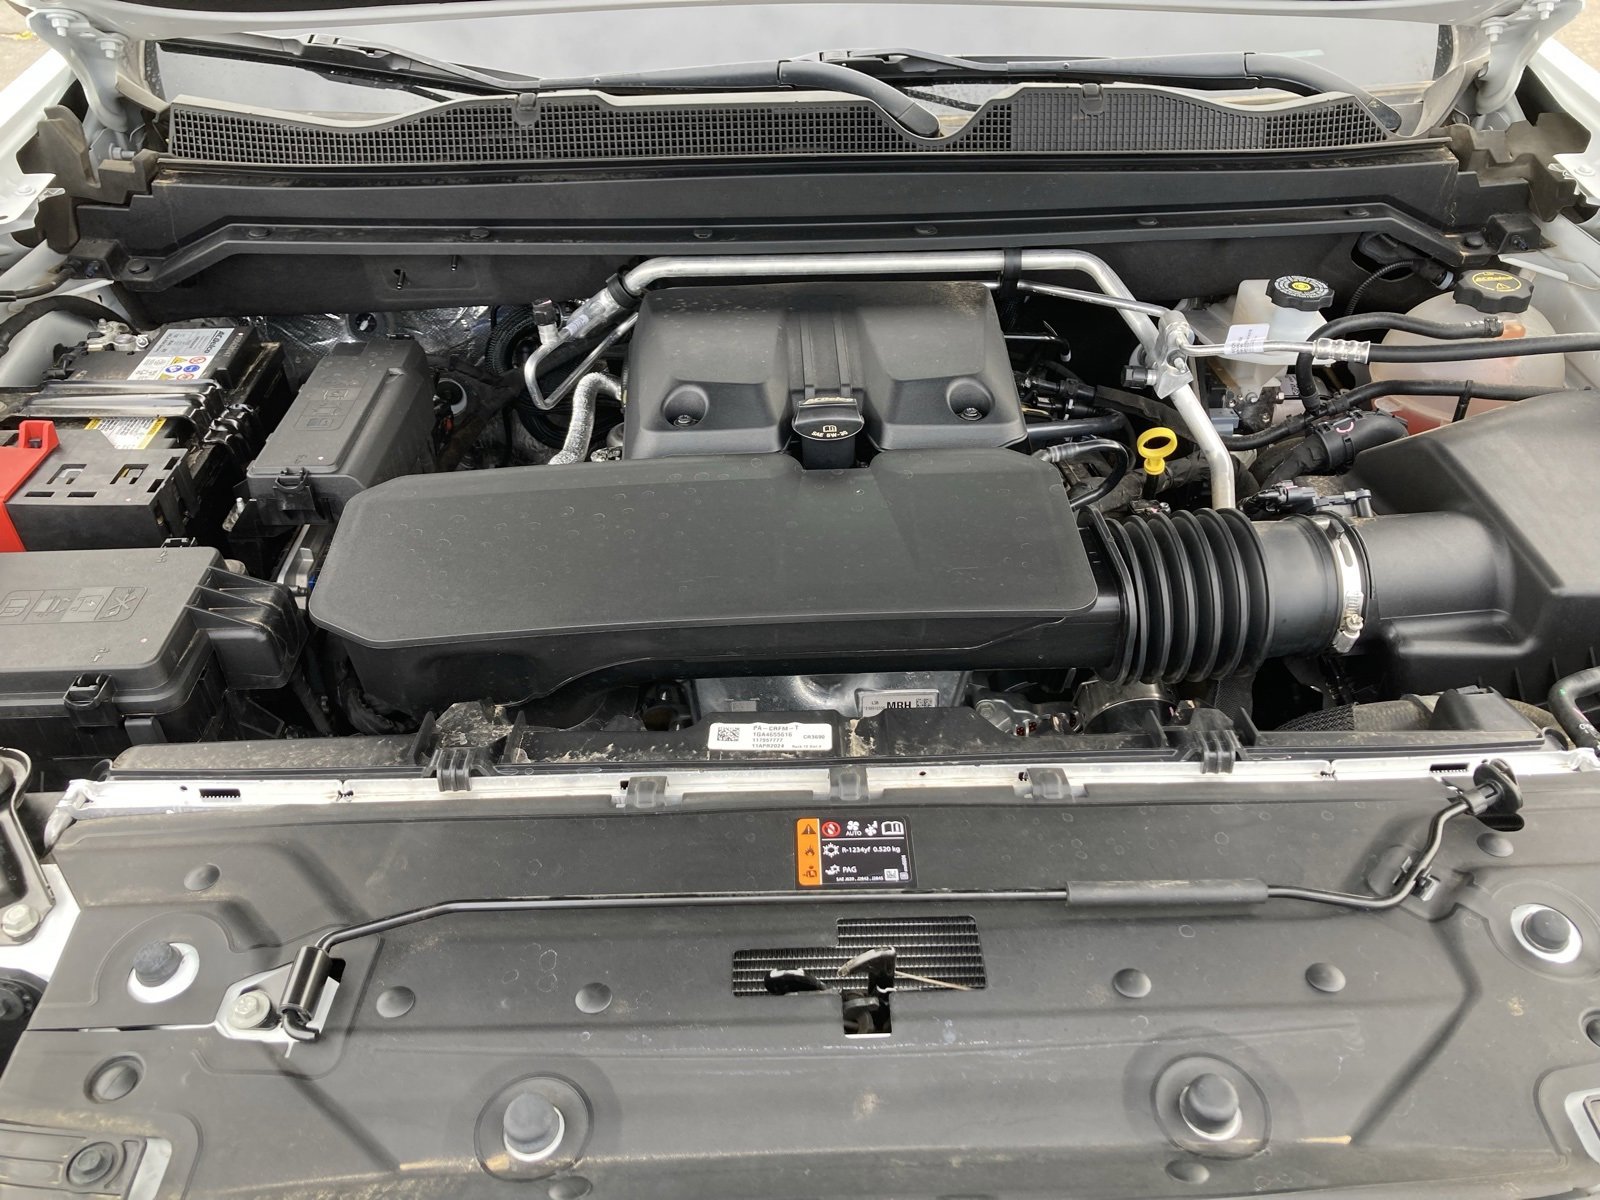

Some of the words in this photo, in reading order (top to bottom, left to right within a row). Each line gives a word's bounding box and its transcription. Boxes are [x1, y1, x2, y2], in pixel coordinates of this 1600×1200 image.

[886, 701, 912, 709] MRH
[841, 845, 871, 854] R-1234yf
[872, 845, 891, 853] 0.520
[891, 845, 901, 854] kg
[842, 865, 857, 873] PAG
